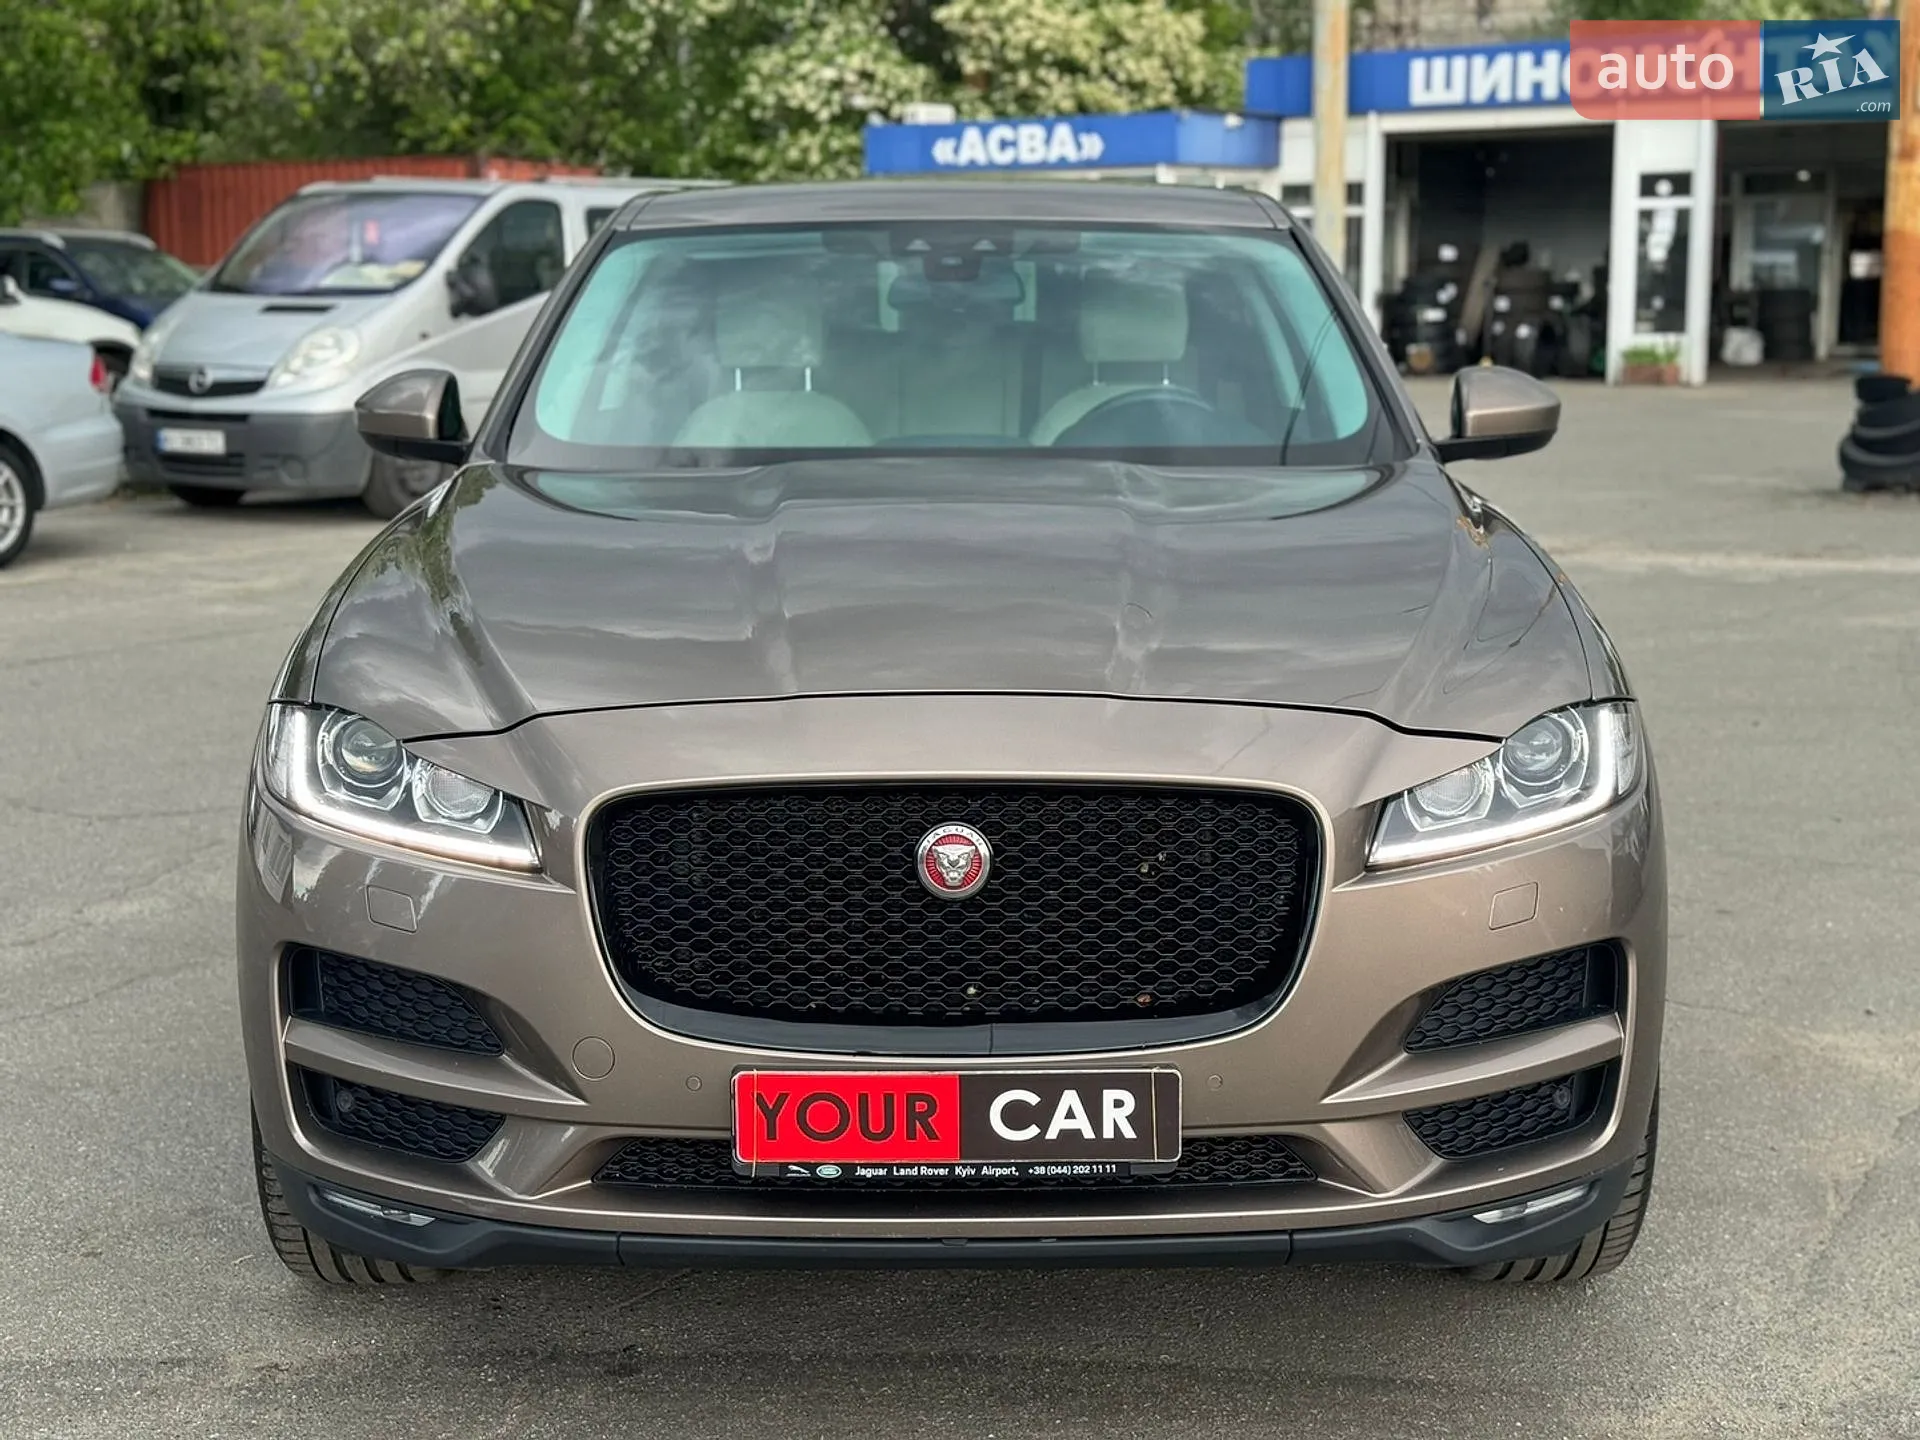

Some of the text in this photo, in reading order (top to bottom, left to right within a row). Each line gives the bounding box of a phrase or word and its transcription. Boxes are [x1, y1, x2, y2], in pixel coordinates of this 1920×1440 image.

[753, 1089, 1138, 1143] YOUR CAR
[855, 1166, 888, 1178] Jaguar
[893, 1166, 918, 1176] Land
[920, 1166, 949, 1176] Rover
[955, 1166, 976, 1178] Kyiv
[1072, 1165, 1090, 1174] 202
